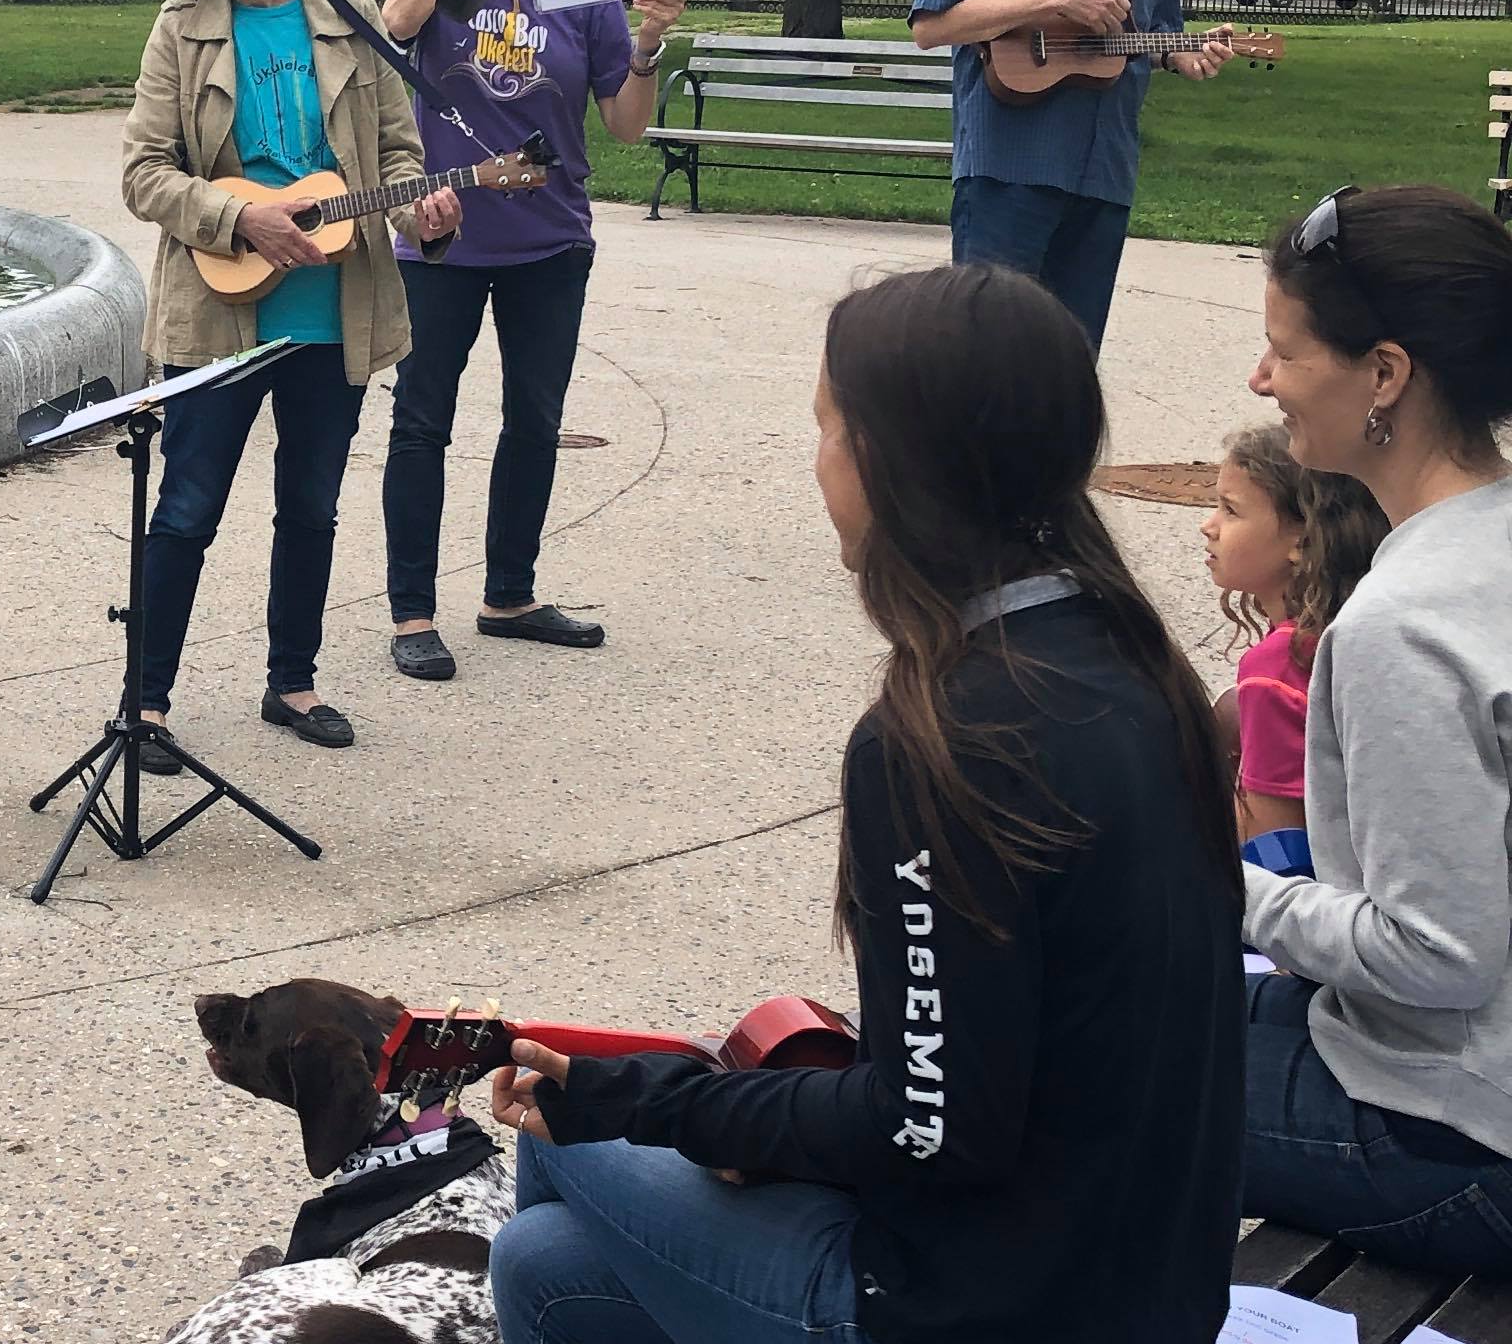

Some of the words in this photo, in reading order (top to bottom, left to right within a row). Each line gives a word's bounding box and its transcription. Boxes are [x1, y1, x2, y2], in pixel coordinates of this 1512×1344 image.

[514, 12, 548, 53] Bay
[892, 849, 944, 1160] YOSEMITE
[1237, 1306, 1268, 1321] YOUR
[1270, 1318, 1301, 1334] BOAT
